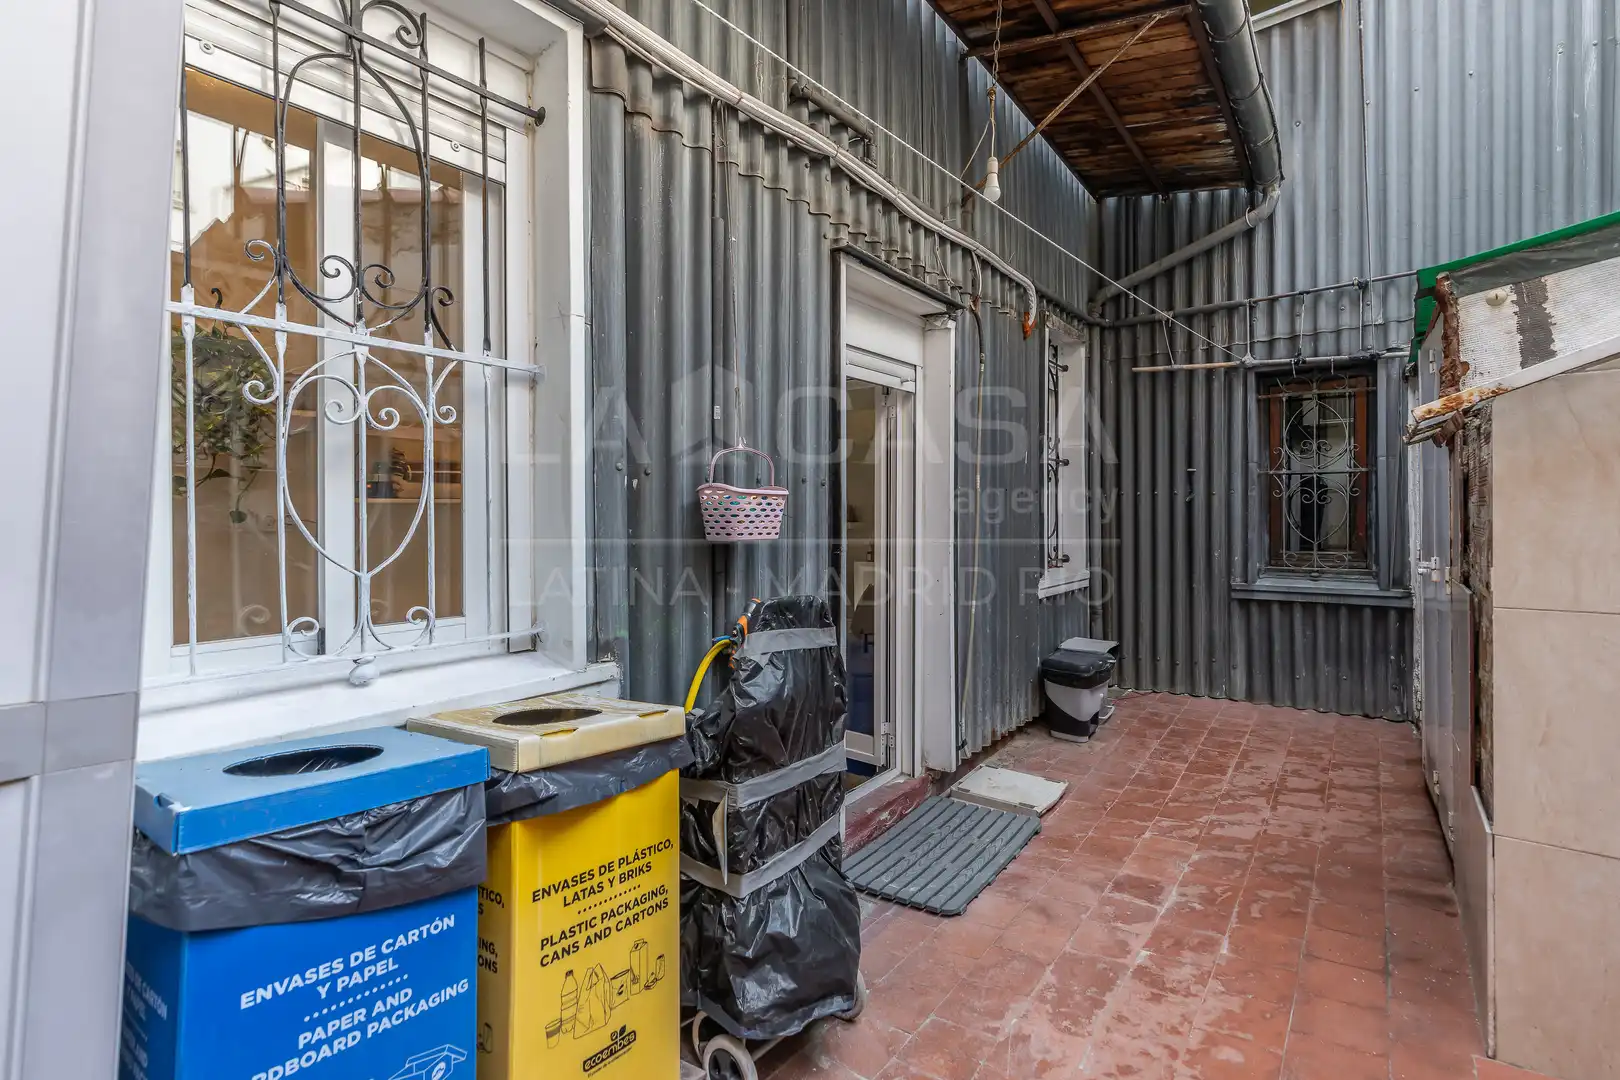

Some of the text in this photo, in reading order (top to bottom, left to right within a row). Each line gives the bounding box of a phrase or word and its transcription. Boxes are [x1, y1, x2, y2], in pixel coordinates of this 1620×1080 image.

[478, 885, 505, 909] TICO,
[531, 838, 674, 903] ENVASES DE PLÁSTICO,
[563, 861, 652, 907] LATAS Y BRIKS
[539, 897, 669, 968] CANS AND CARTONS
[540, 916, 597, 951] PLASTIC
[600, 884, 669, 925] PACKAGING,
[240, 957, 344, 1010] ENVASES
[350, 945, 377, 968] DE
[381, 914, 455, 955] CARTÓN
[316, 957, 399, 1000] Y PAPEL
[298, 987, 413, 1050] PAPER AND
[366, 978, 469, 1039] PACKAGING
[584, 1031, 635, 1070] ecoembes
